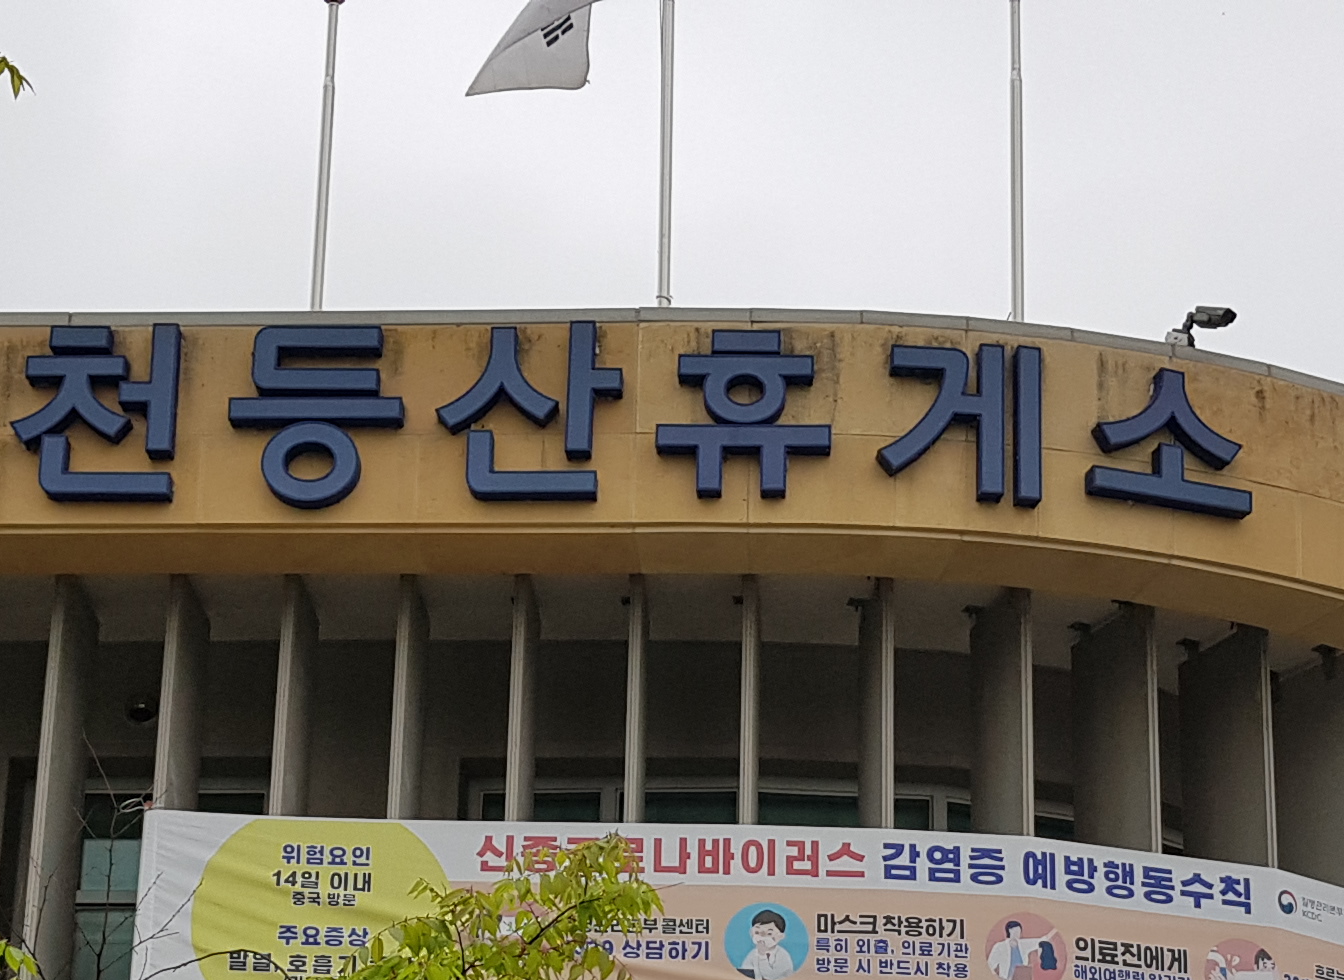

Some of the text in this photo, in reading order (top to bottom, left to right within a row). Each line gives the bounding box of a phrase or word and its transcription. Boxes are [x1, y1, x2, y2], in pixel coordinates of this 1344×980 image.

[10, 320, 1253, 519] 천등산휴게소
[281, 843, 372, 868] 위험요인
[272, 870, 372, 893] 14일 이내
[881, 842, 1006, 886] 감염증
[1022, 850, 1253, 914] 예방행동수칙
[291, 891, 357, 907] 중국 방문
[277, 924, 370, 947] 주요증상
[816, 913, 966, 940] 마스크 착용하기
[621, 938, 710, 961] 상담하기
[815, 938, 849, 955] 특히
[901, 940, 969, 959] 의료기관
[1074, 936, 1189, 974] 의료진에게
[815, 957, 969, 979] 방문 시 반드시 착용
